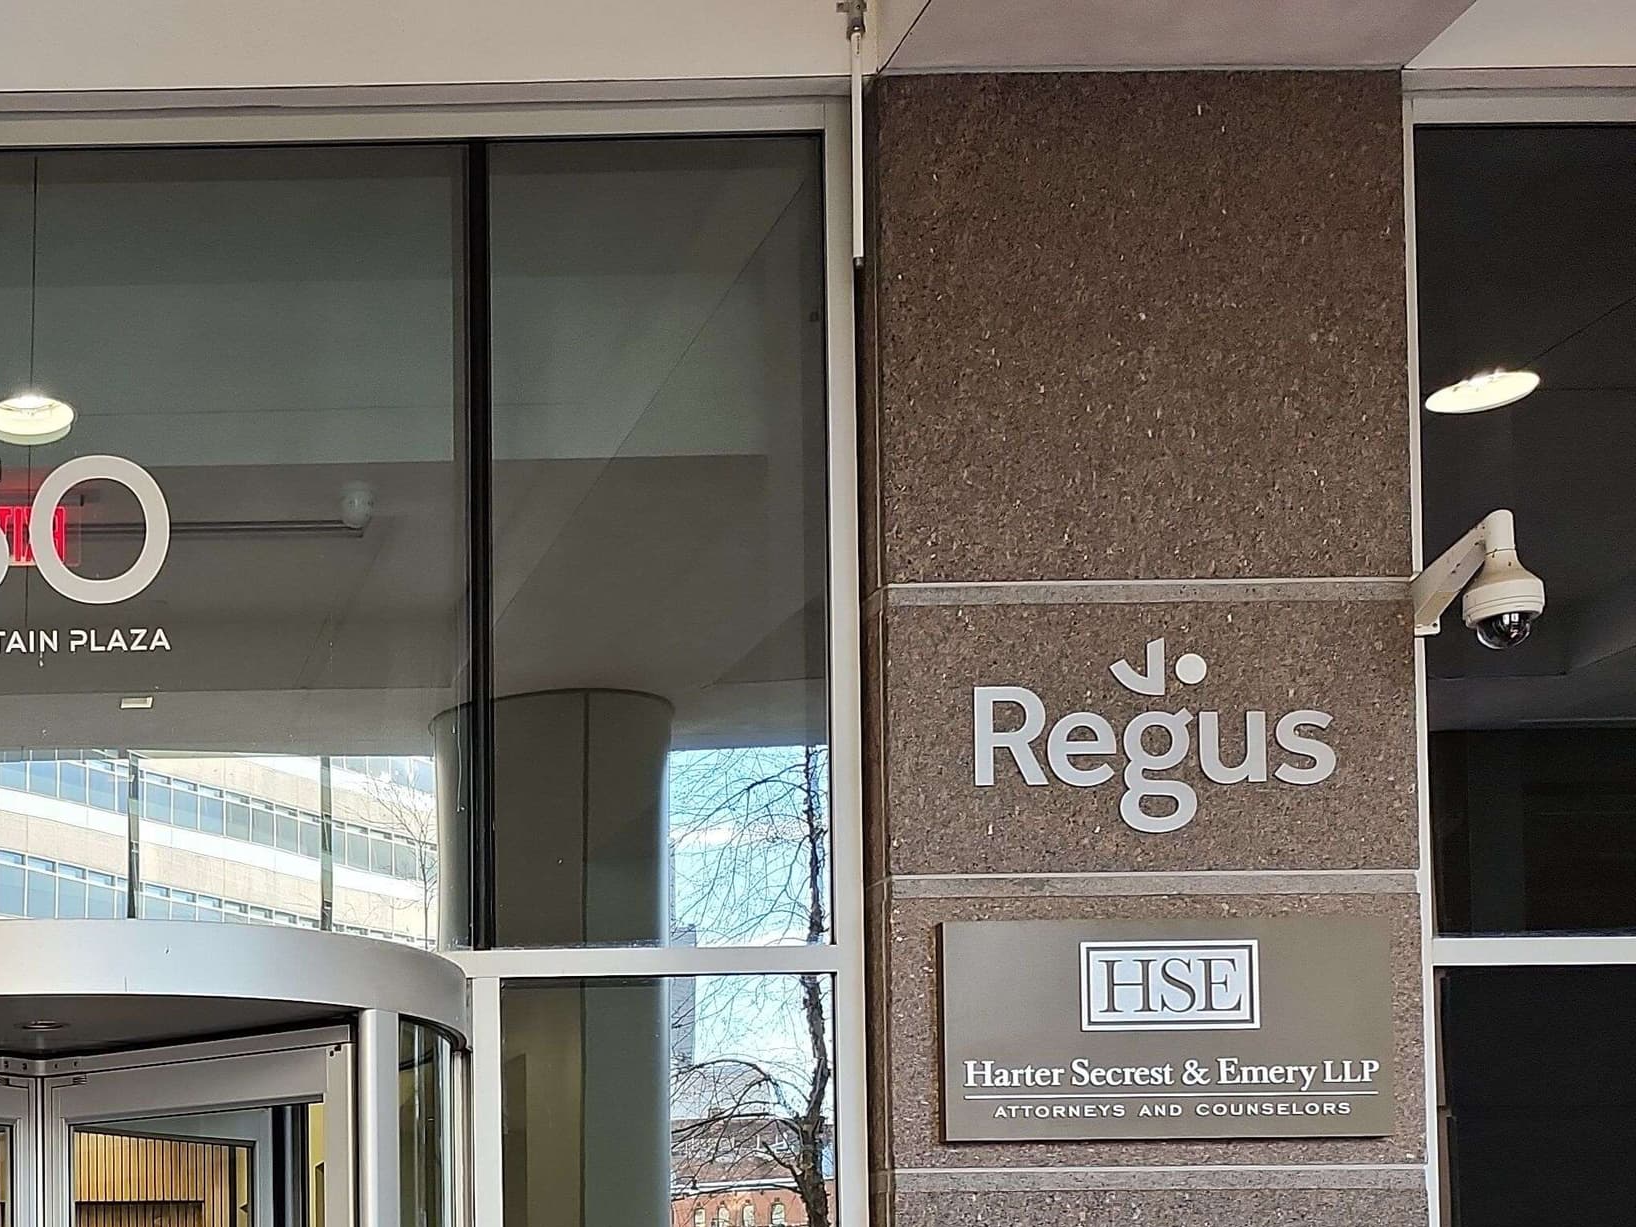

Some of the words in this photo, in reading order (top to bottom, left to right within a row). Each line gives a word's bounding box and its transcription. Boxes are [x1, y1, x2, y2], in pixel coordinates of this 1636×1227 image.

[69, 628, 172, 653] PLAZA
[972, 684, 1338, 834] Regus
[1097, 956, 1244, 1014] HSE
[963, 1060, 1065, 1088] Harter
[1070, 1057, 1175, 1087] Secrest
[1180, 1058, 1212, 1086] &
[1216, 1056, 1319, 1092] Emery
[1322, 1059, 1381, 1084] LLP
[993, 1103, 1126, 1119] ATTORNEYS
[1138, 1103, 1183, 1118] AND
[1195, 1101, 1352, 1117] COUNSELORS
